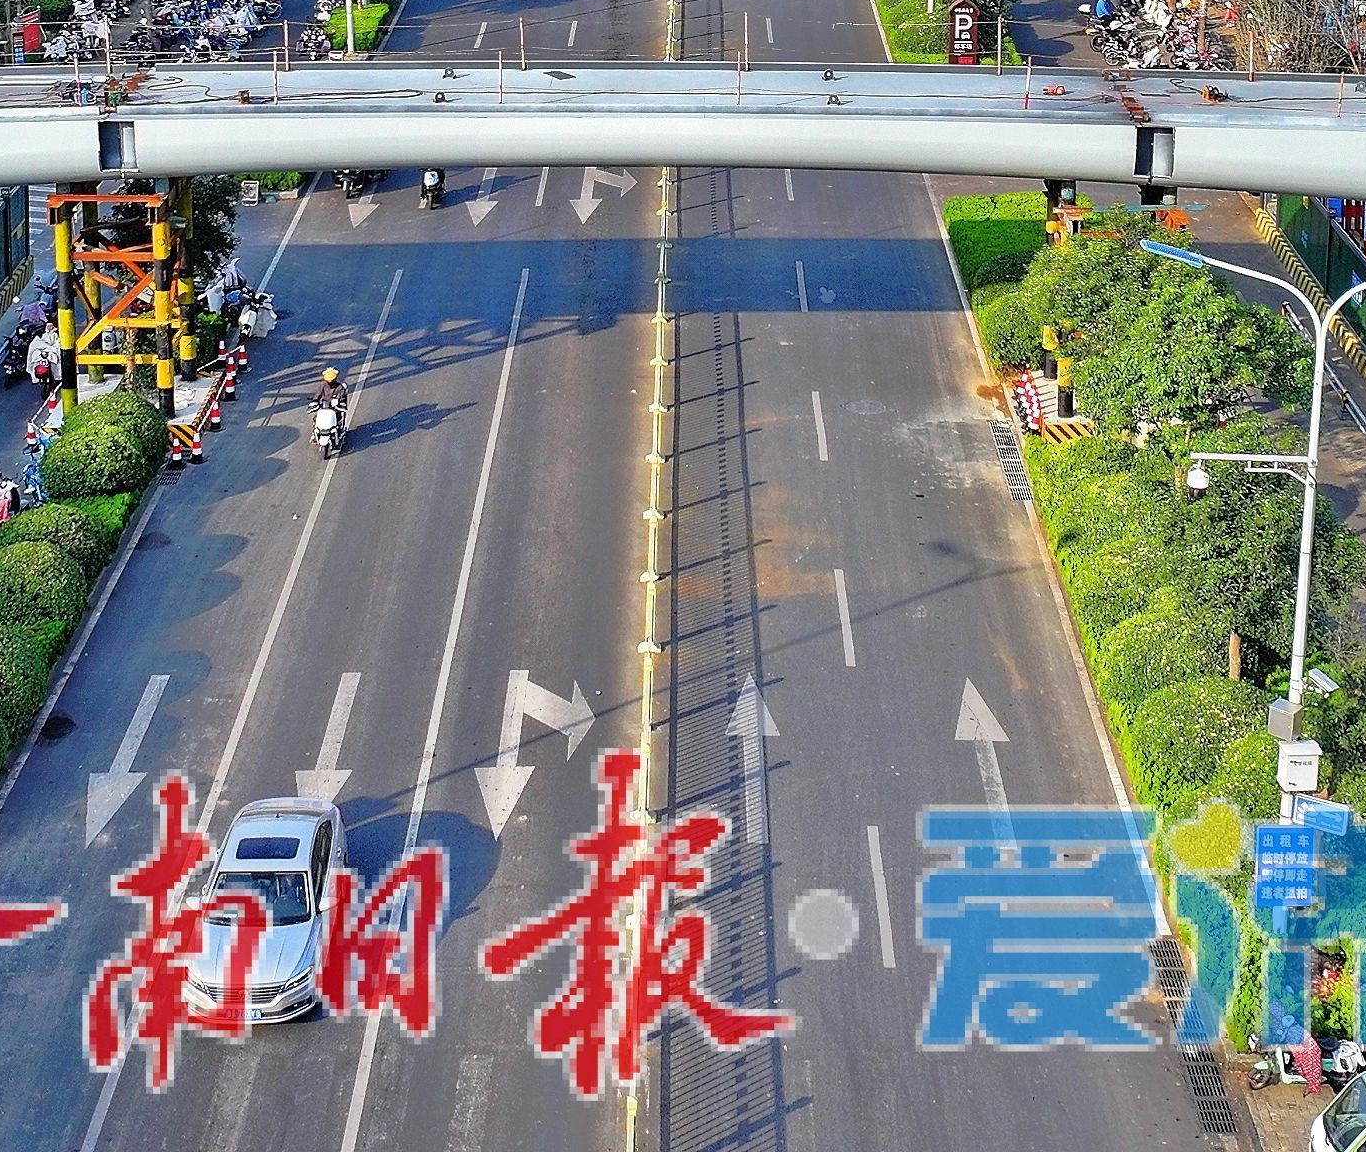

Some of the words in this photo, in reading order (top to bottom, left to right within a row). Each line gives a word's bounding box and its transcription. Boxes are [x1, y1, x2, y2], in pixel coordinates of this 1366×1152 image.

[955, 14, 973, 39] P
[1262, 834, 1310, 847] 出租车
[1261, 852, 1308, 865] 临时停放
[1261, 869, 1307, 882] 即停即走
